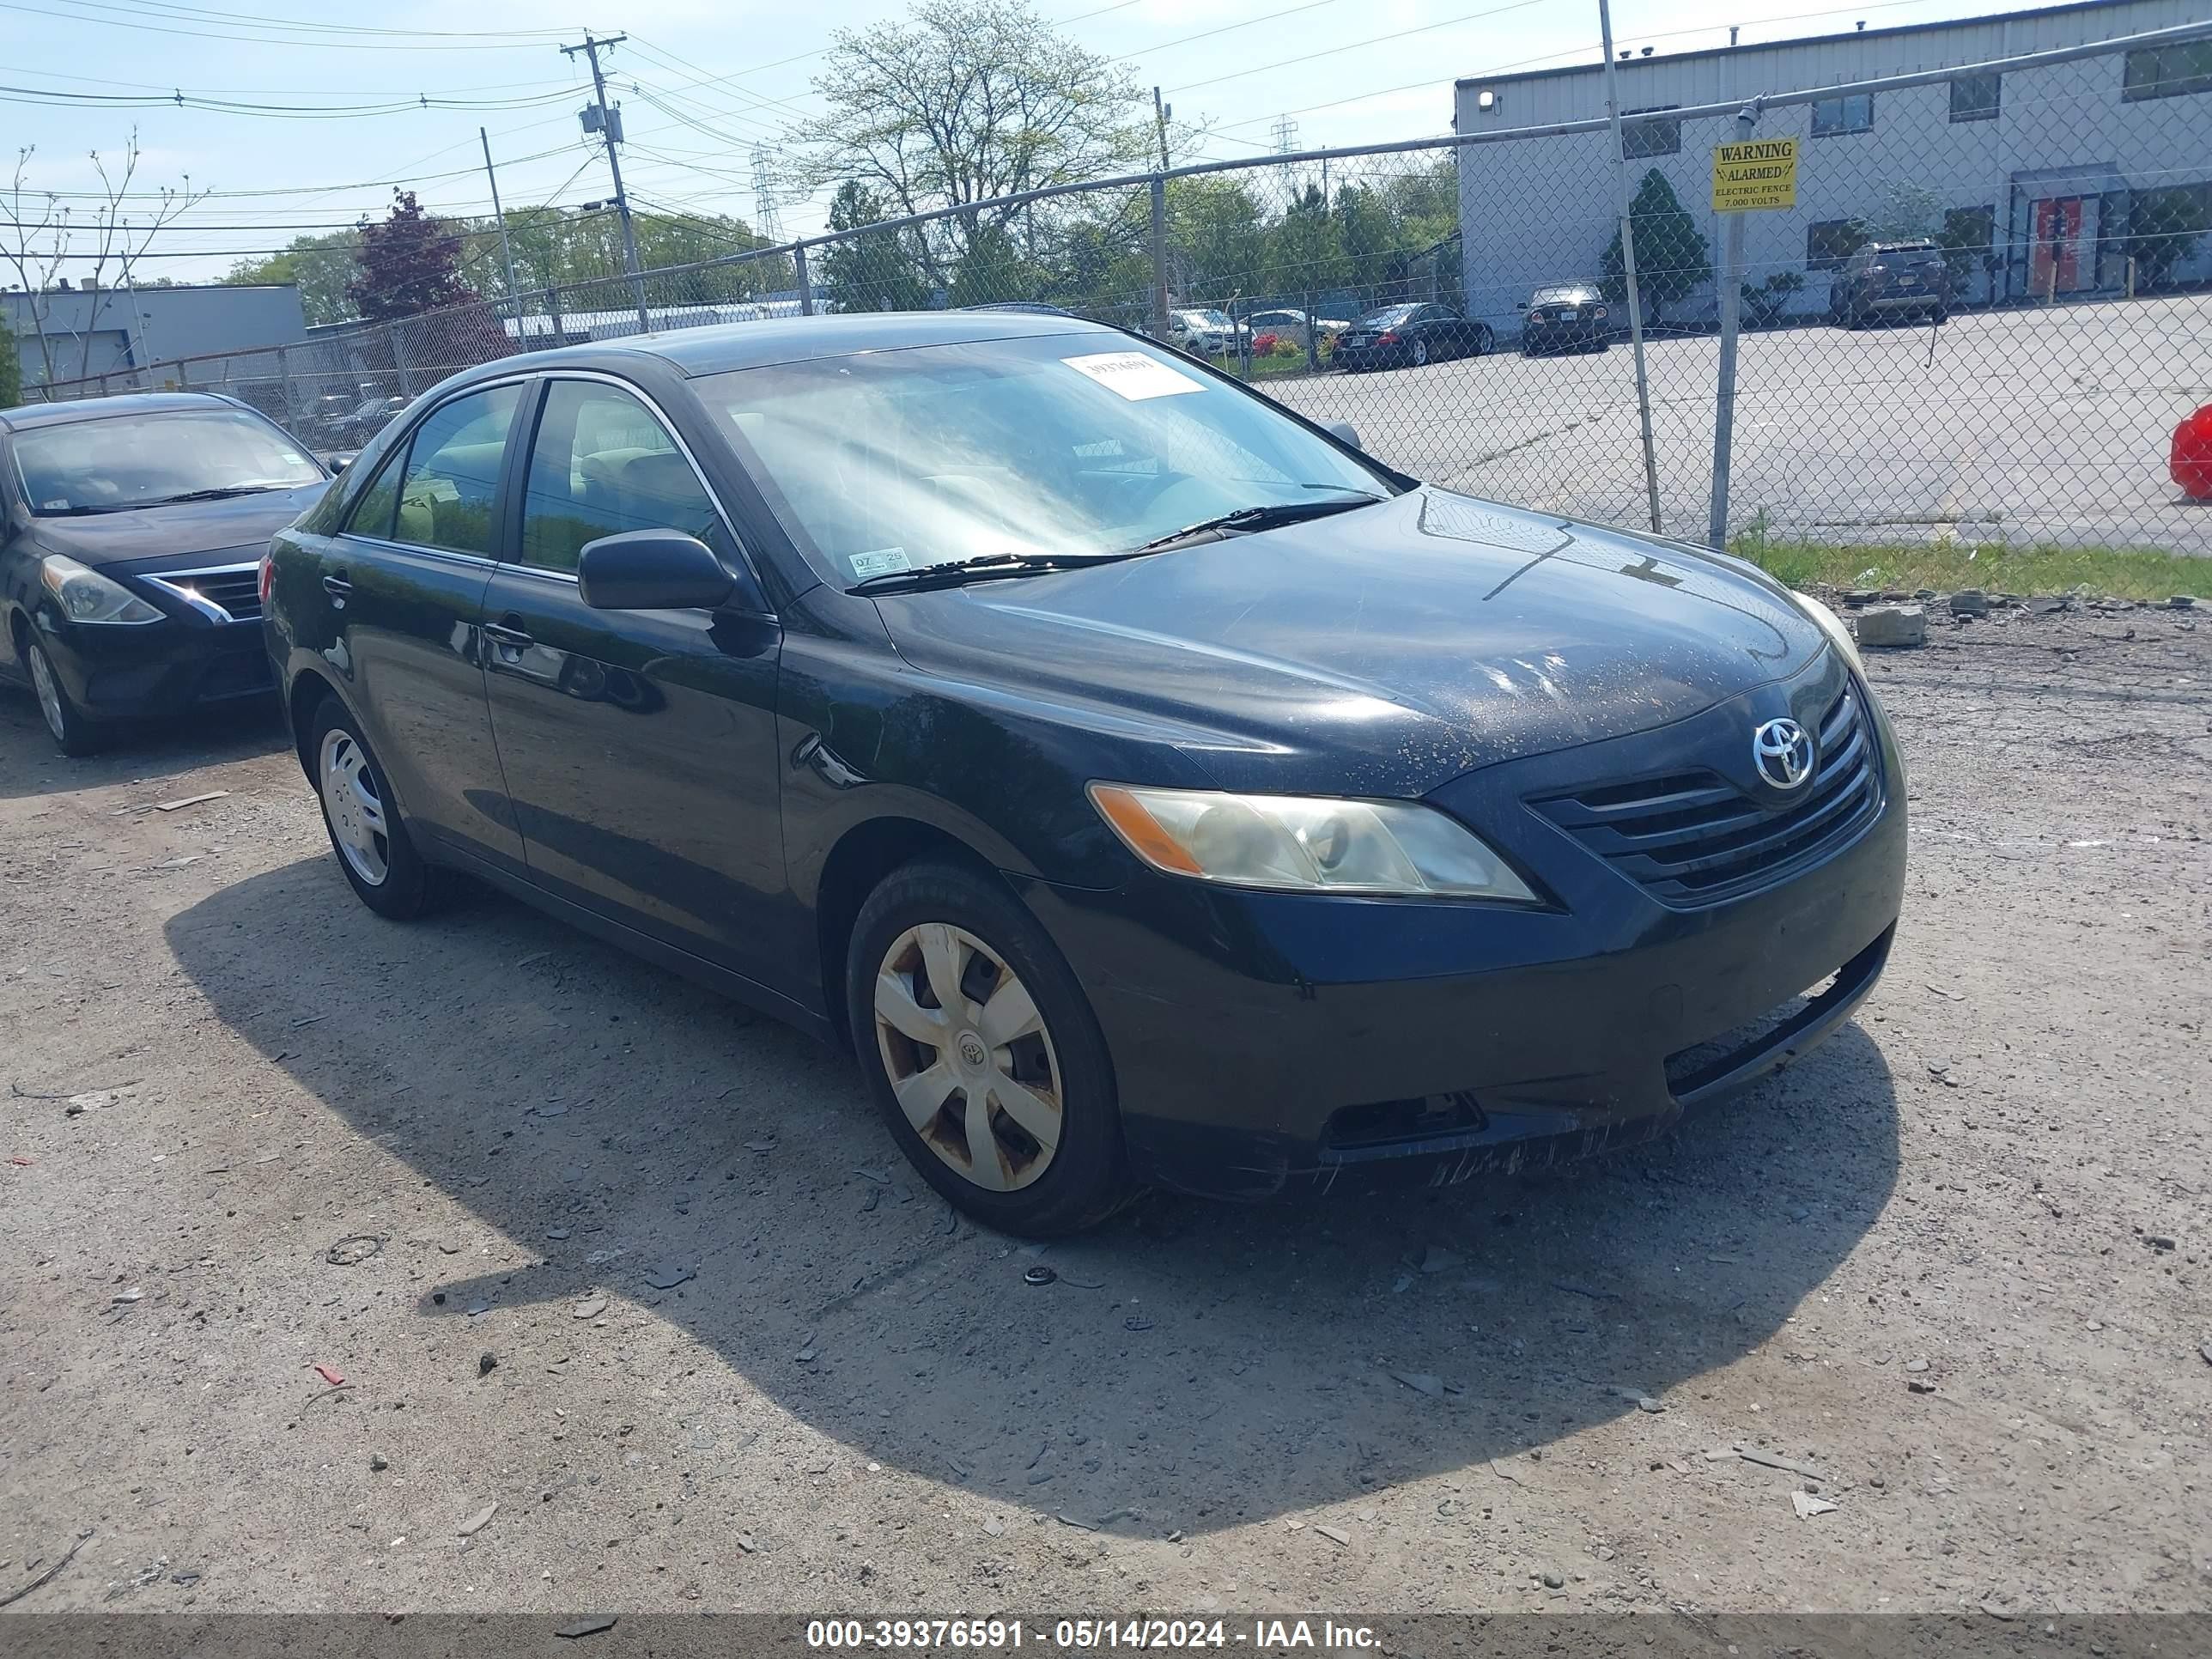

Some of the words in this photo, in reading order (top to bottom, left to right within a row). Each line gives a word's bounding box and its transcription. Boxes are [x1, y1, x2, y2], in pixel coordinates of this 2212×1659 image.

[1720, 142, 1793, 162] WARNING
[1727, 166, 1782, 182] ALARMED
[1716, 186, 1759, 197] ELECTRIC
[1761, 184, 1791, 193] FENCE
[1752, 197, 1780, 205] VOLTS
[855, 557, 870, 567] 07
[886, 552, 902, 562] 25
